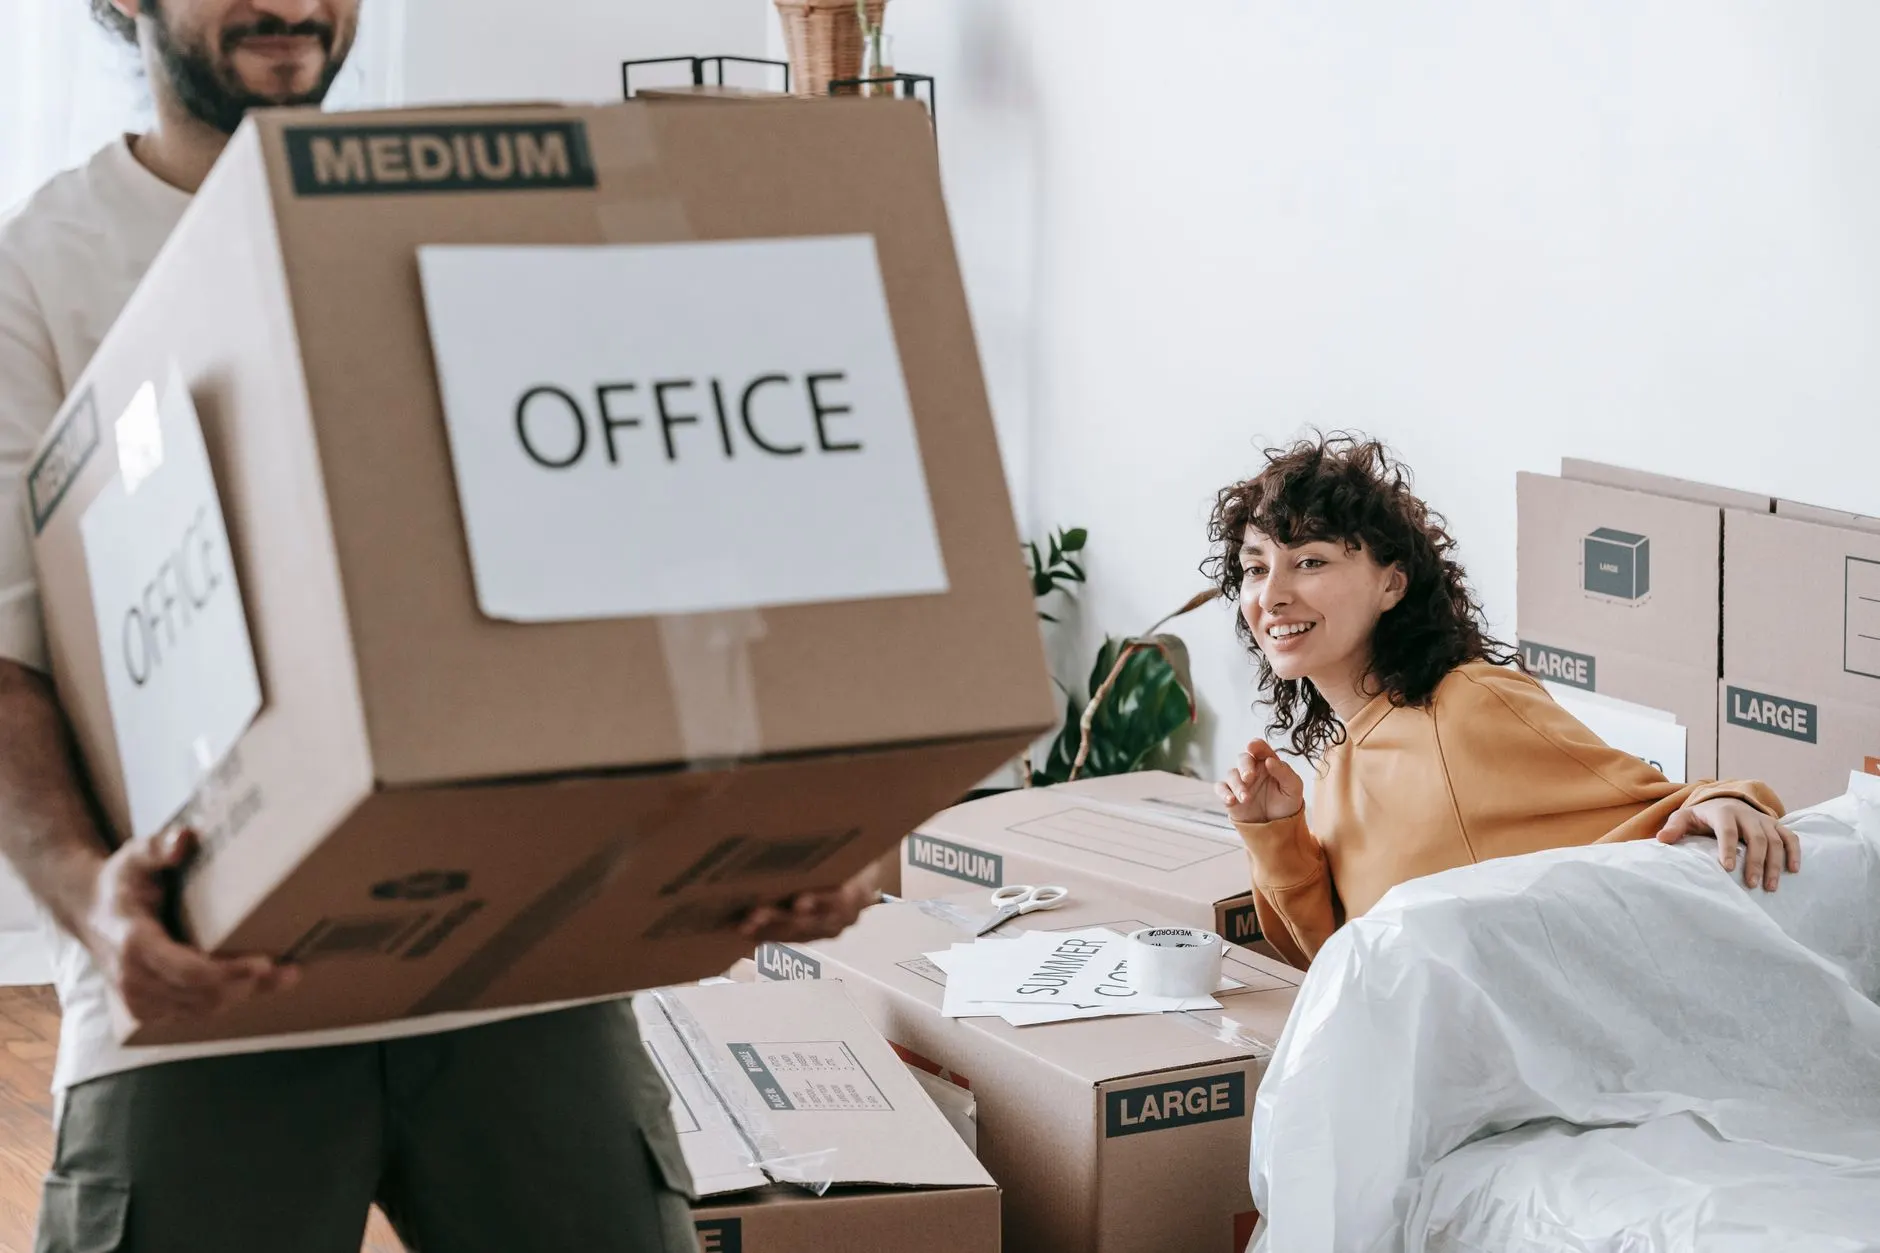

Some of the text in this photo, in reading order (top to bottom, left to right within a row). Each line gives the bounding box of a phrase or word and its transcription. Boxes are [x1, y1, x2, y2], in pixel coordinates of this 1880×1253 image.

[309, 132, 569, 184] MEDIUM
[515, 370, 862, 469] OFFICE
[1525, 647, 1588, 684] LARGE
[1734, 693, 1808, 733] LARGE
[914, 838, 995, 882] MEDIUM
[1156, 928, 1192, 937] WEXFORD
[763, 943, 815, 980] LARGE
[1016, 938, 1108, 996] SUMMER
[1119, 1081, 1231, 1127] LARGE
